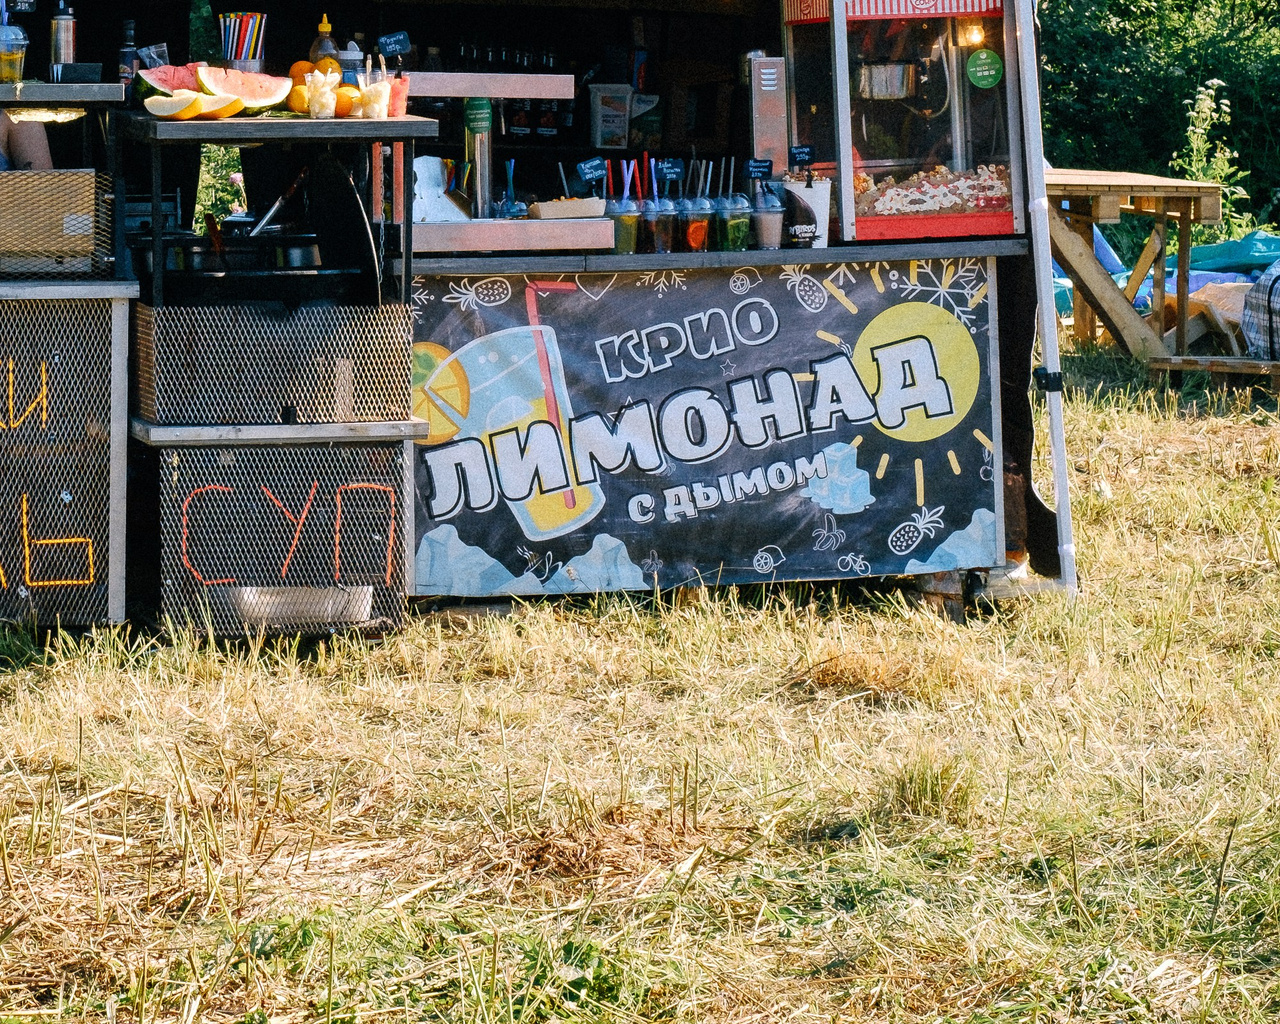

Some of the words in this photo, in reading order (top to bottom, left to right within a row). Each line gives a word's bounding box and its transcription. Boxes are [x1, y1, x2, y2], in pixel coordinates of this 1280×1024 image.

[595, 296, 780, 383] КРИО
[423, 334, 957, 523] ЛИМОНАД
[182, 480, 396, 588] СУП
[663, 451, 829, 523] ДЫМОМ
